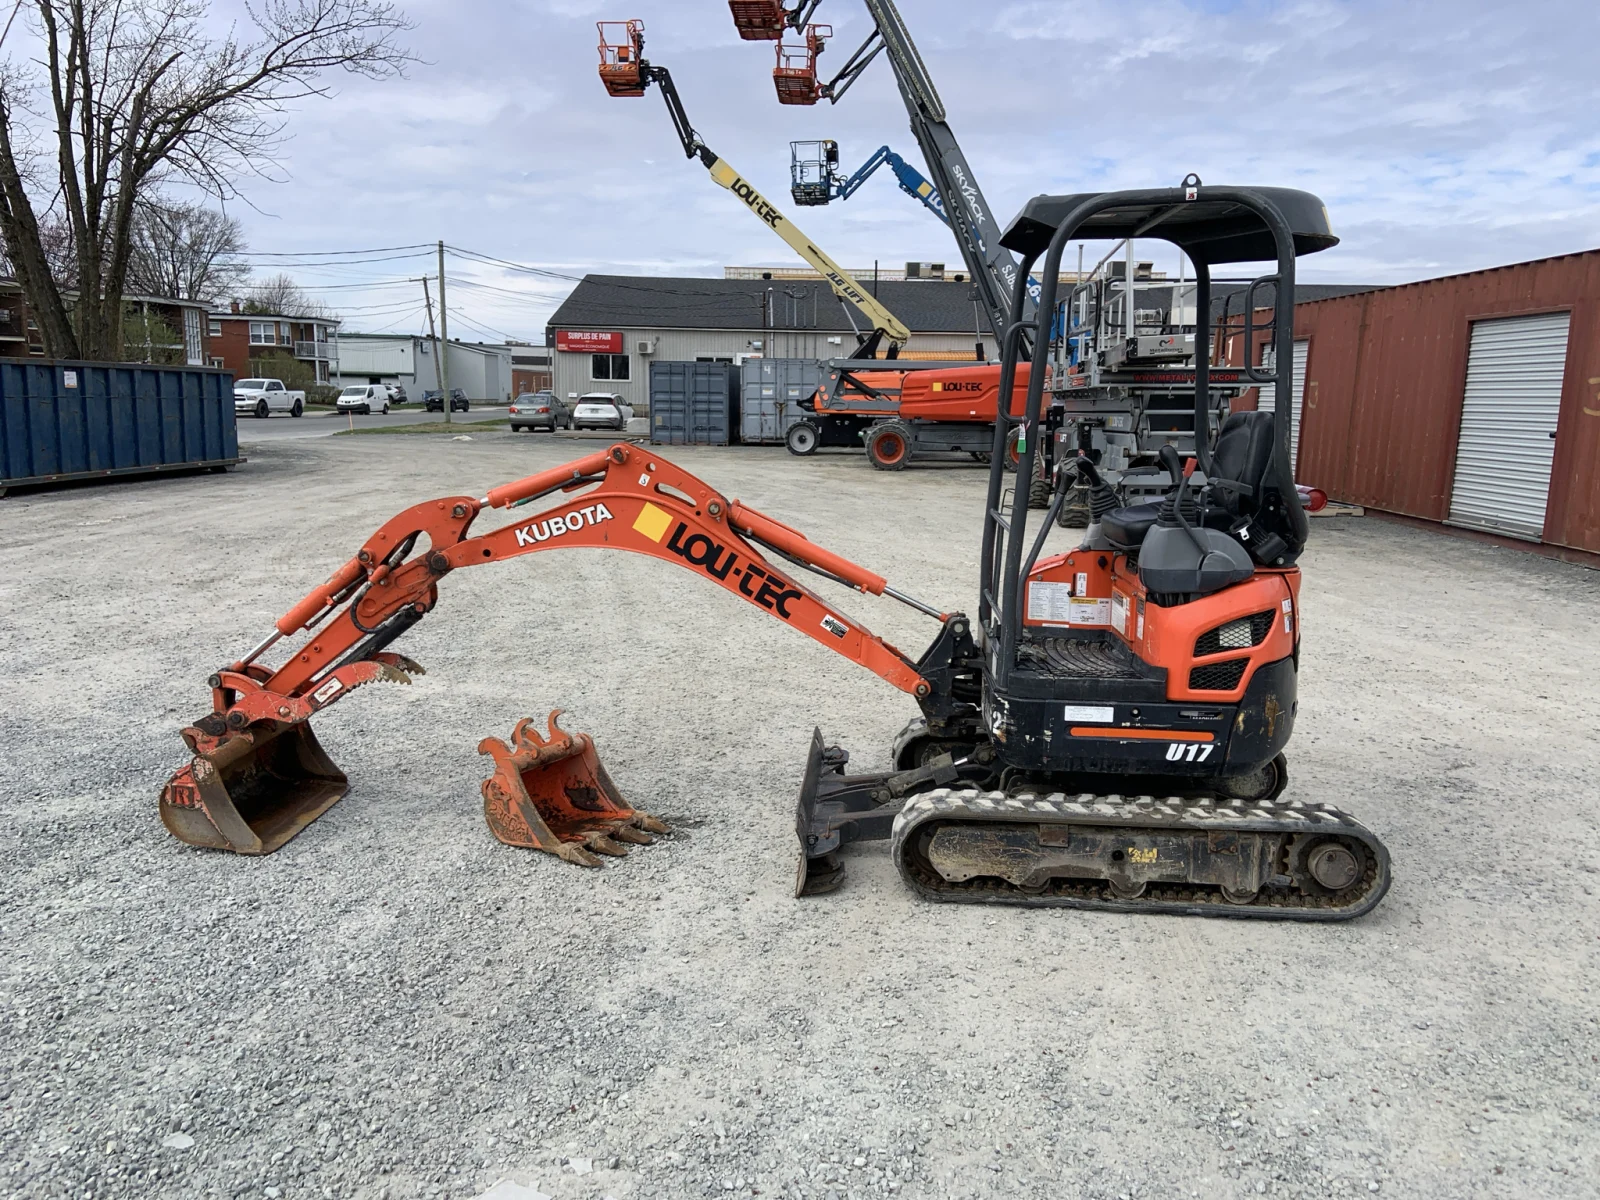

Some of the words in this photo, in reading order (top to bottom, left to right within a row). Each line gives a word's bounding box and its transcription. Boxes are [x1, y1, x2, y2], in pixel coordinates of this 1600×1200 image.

[952, 164, 986, 225] SKYJACK
[826, 272, 845, 287] JLG
[842, 286, 865, 303] LIFT
[567, 332, 591, 340] SURPLUS
[764, 365, 771, 375] 4
[514, 503, 614, 547] KUBOTA
[1165, 743, 1215, 762] U17
